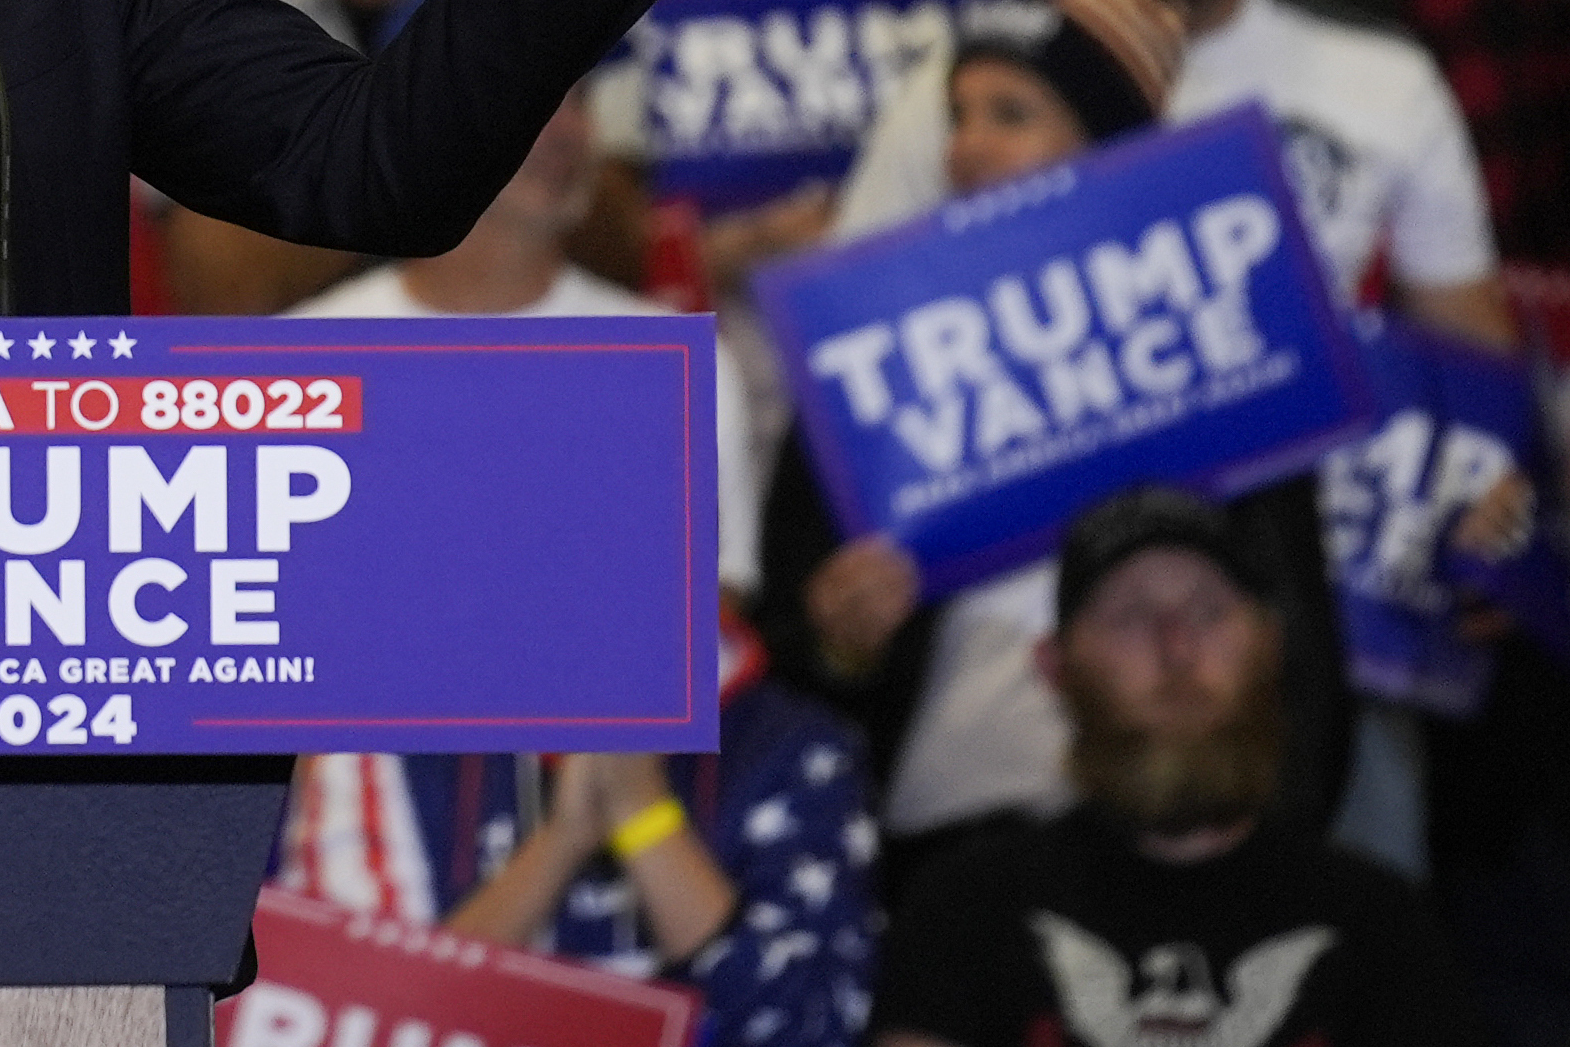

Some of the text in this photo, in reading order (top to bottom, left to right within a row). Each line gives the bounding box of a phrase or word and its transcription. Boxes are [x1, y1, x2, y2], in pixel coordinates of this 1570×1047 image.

[806, 189, 1282, 428] TRUMP
[31, 380, 120, 431] TO
[141, 379, 344, 430] 88022
[895, 282, 1268, 477] VANCE
[59, 657, 176, 683] GREAT
[189, 657, 316, 683] AGAIN!
